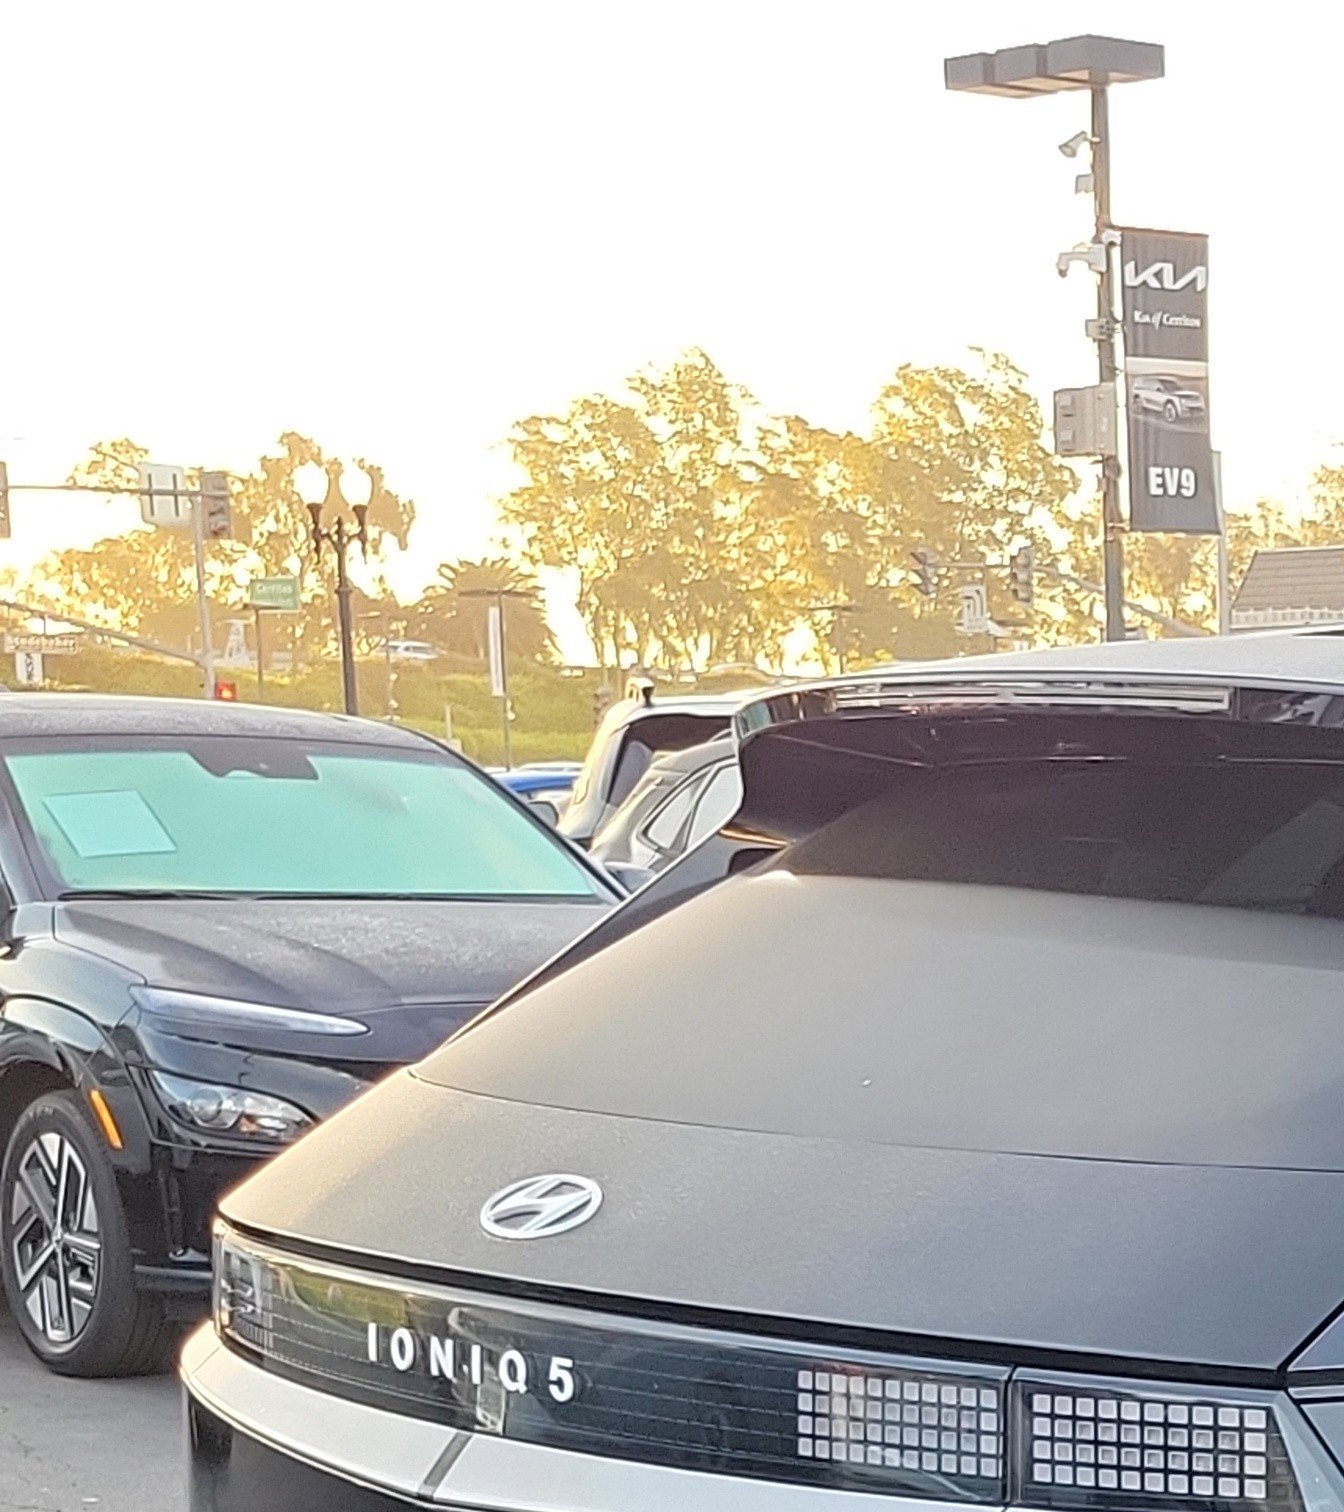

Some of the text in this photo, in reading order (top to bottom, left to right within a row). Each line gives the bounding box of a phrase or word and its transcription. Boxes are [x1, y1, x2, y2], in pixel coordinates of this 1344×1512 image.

[1148, 466, 1196, 497] EV9
[368, 1321, 575, 1402] IONIQ 5
